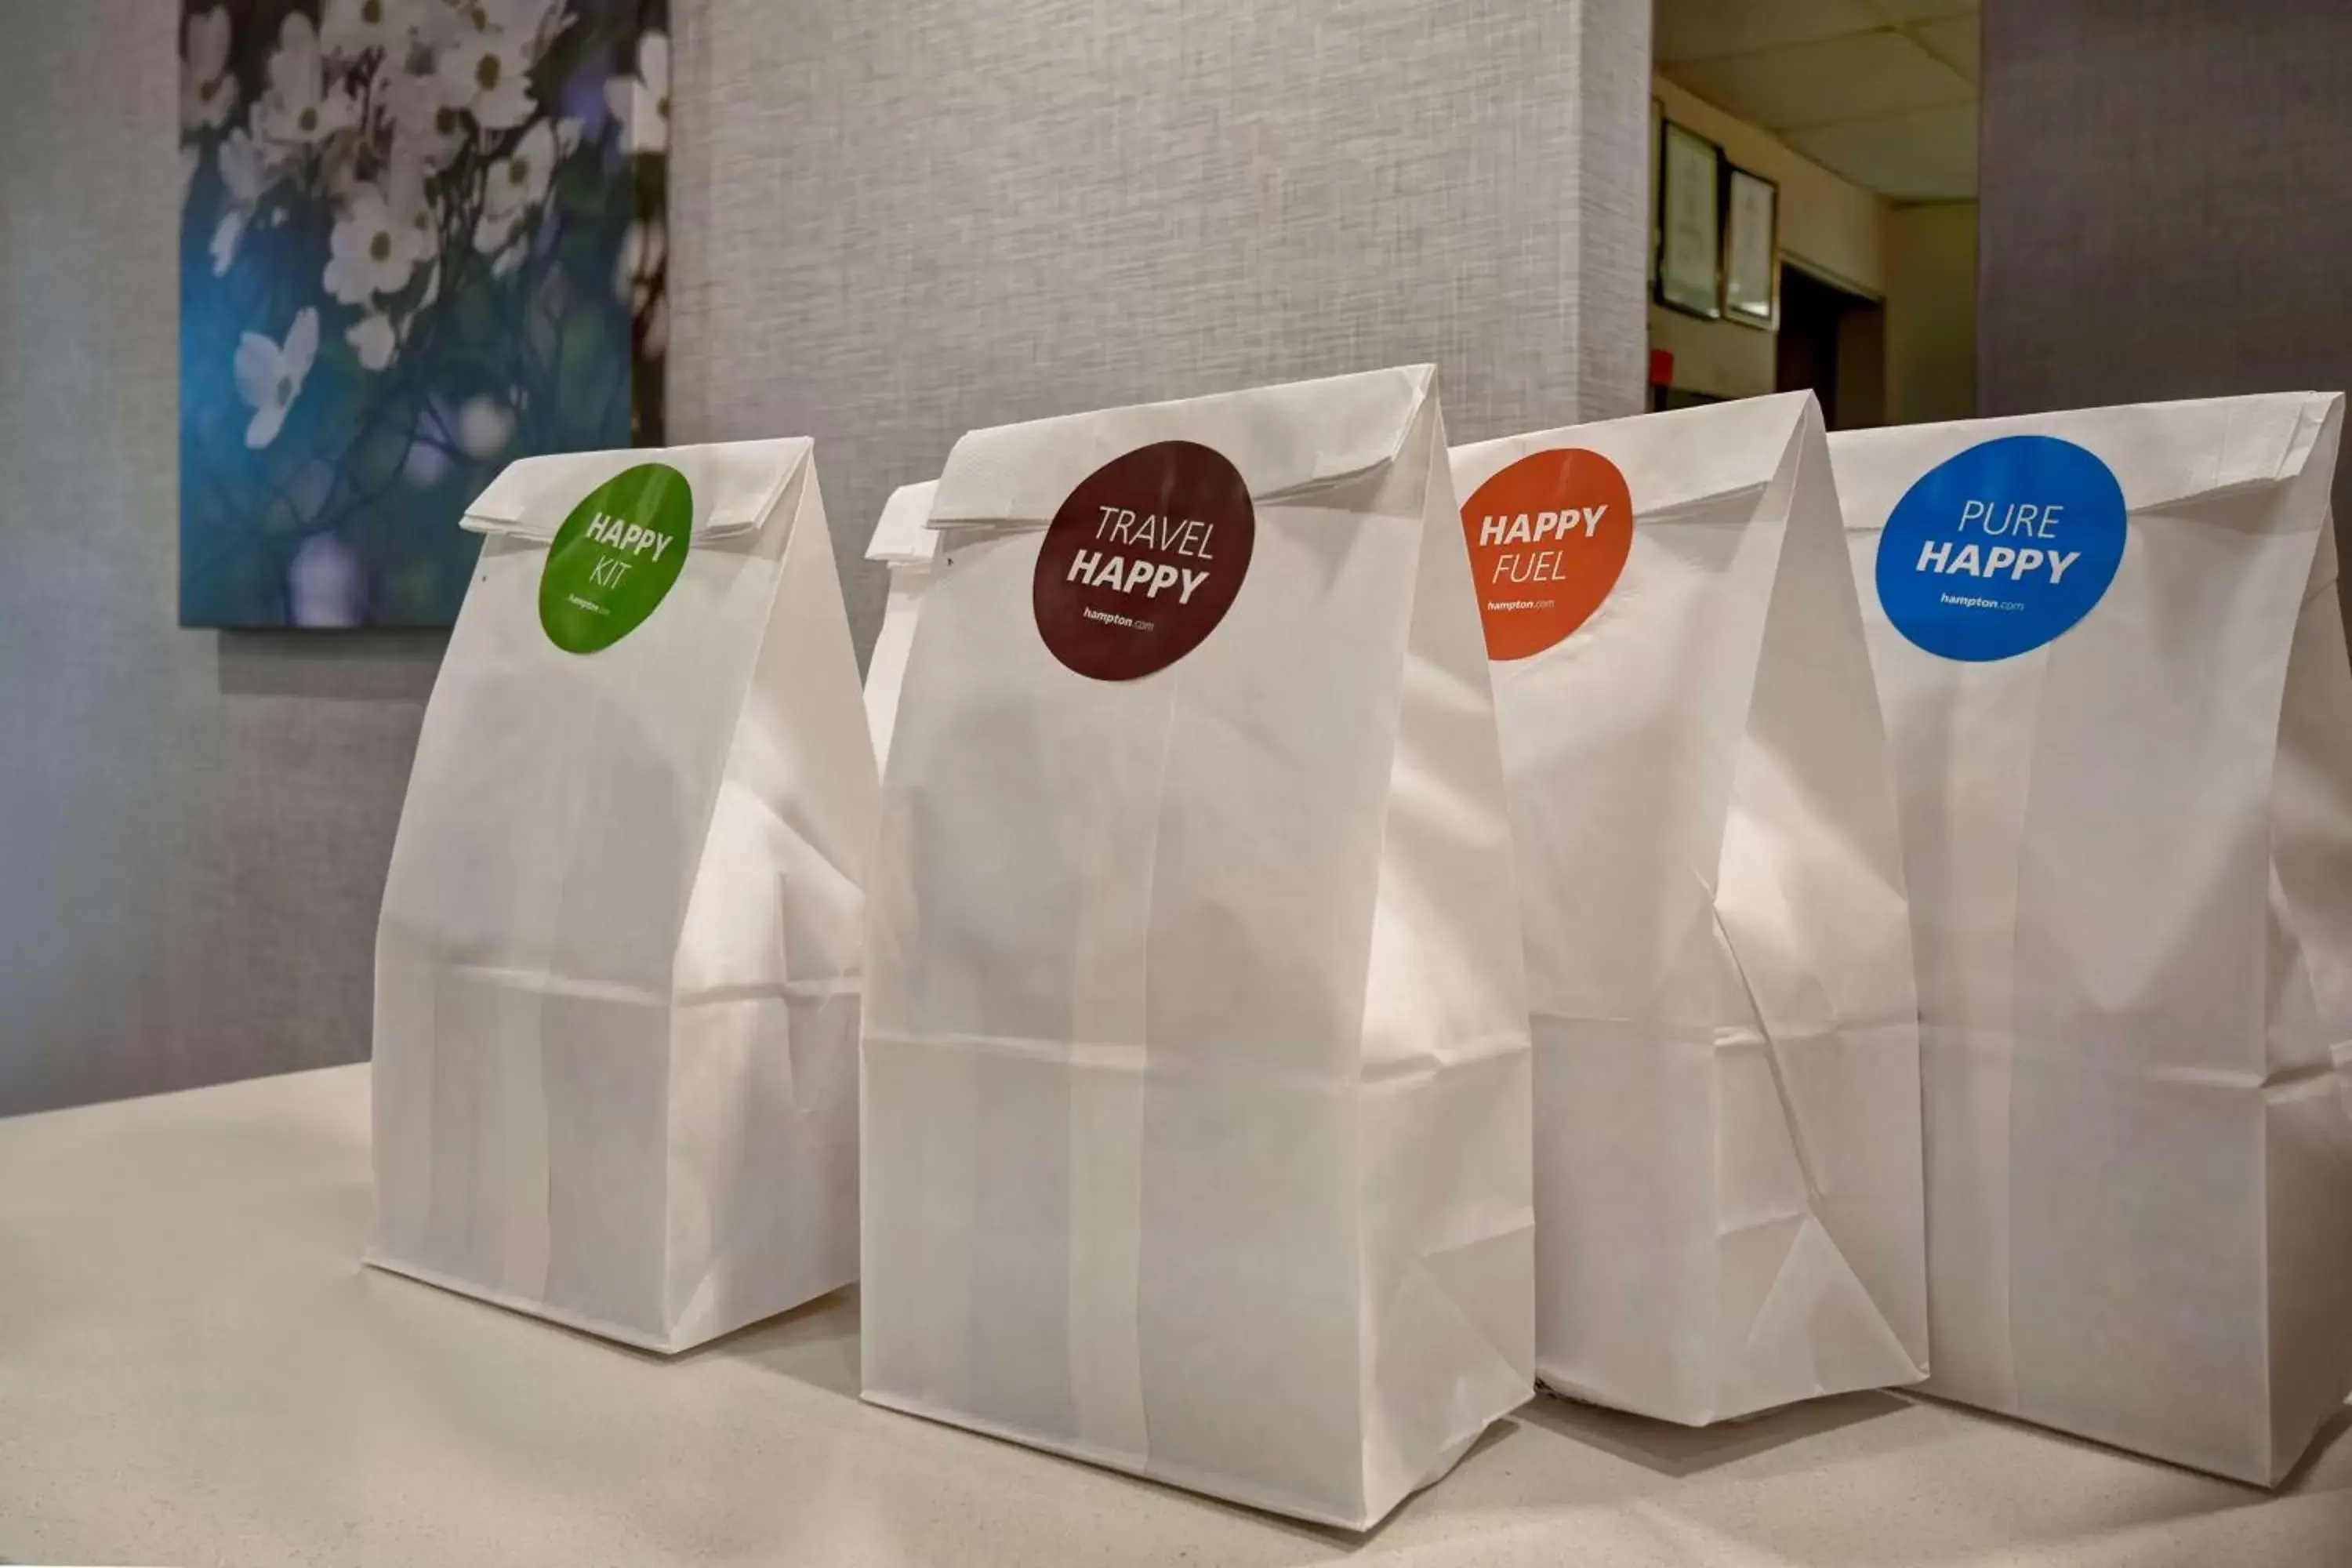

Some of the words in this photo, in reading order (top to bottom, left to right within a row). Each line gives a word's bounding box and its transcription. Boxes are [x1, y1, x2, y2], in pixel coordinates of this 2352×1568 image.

[586, 512, 673, 562] HAPPY
[1095, 506, 1214, 559] TRAVEL
[1479, 504, 1609, 546] HAPPY
[1958, 499, 2063, 539] PURE
[590, 555, 632, 589] KIT
[1066, 549, 1210, 604] HAPPY
[1492, 550, 1566, 584] FUEL
[1916, 540, 2081, 584] HAPPY
[1083, 607, 1154, 631] hampton.com
[1487, 599, 1555, 612] hampton.com
[1940, 593, 2025, 612] hampton.com
